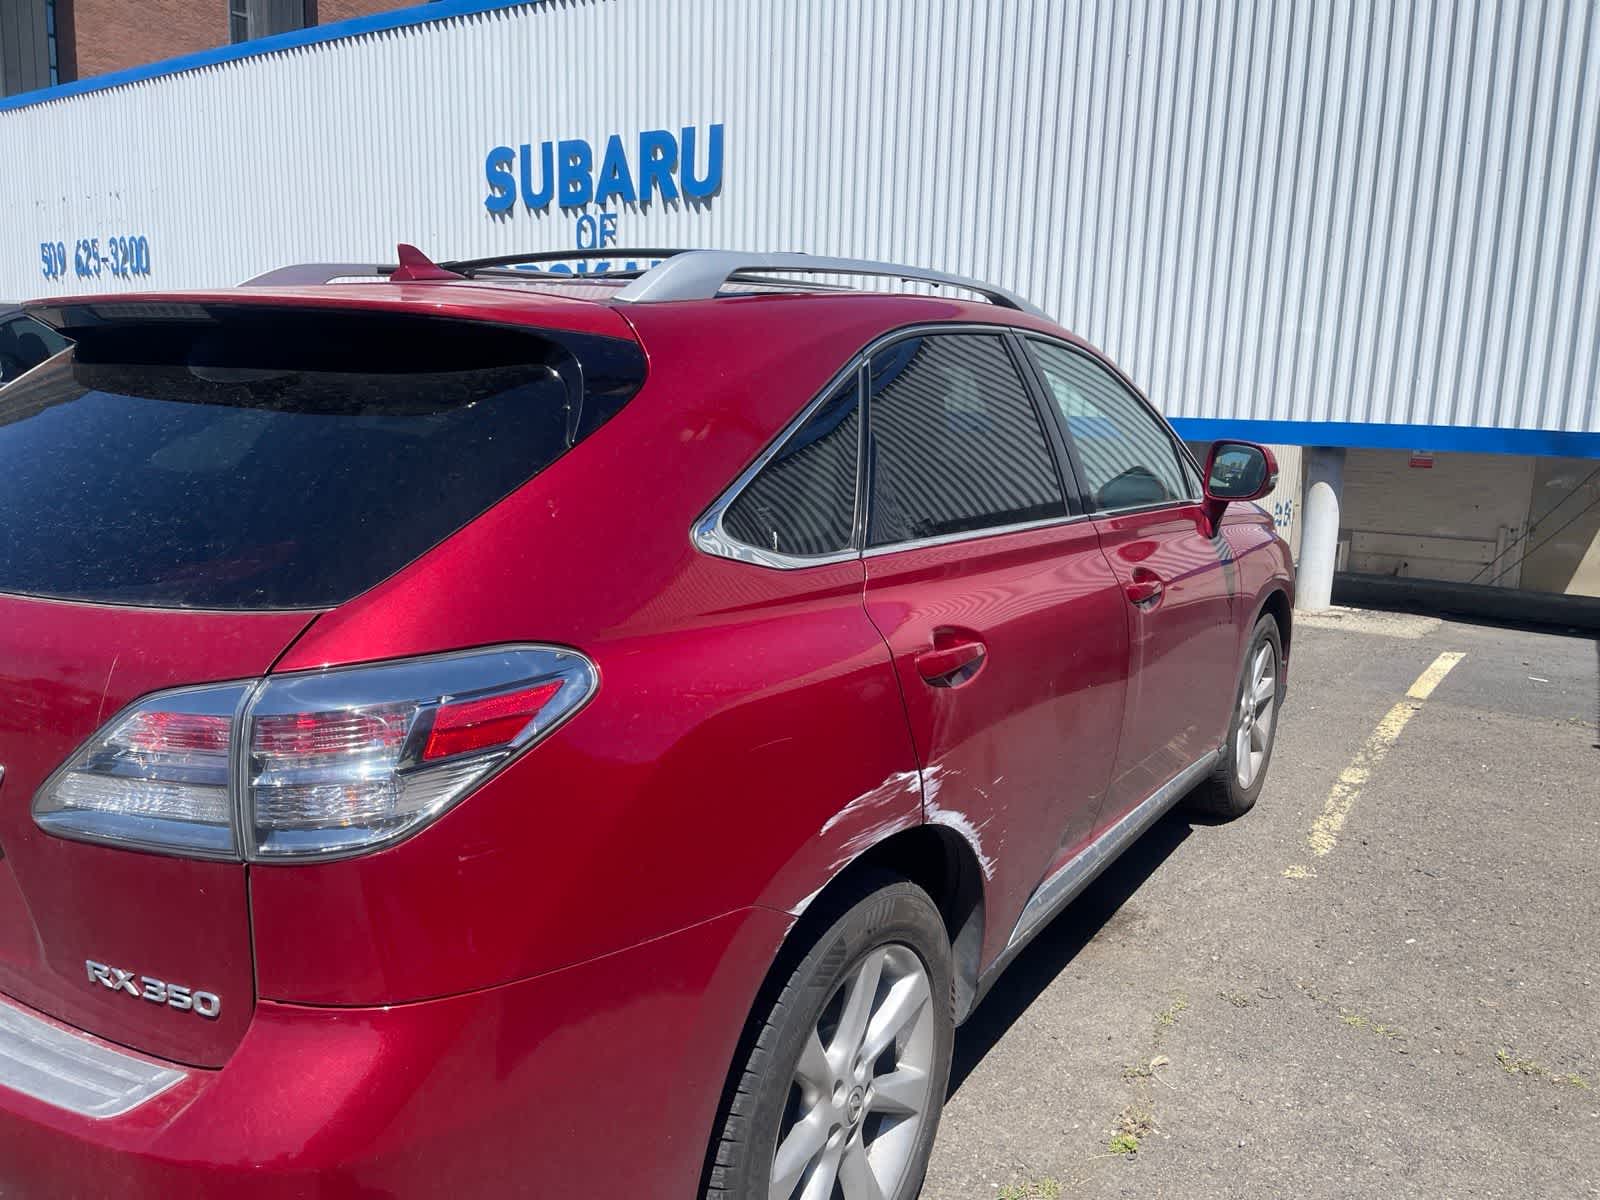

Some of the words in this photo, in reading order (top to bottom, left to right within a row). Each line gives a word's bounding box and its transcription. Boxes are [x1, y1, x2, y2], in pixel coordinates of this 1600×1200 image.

[485, 124, 724, 211] SUBARU
[577, 213, 617, 249] OF
[40, 241, 66, 277] 509
[75, 235, 150, 276] 625-3200
